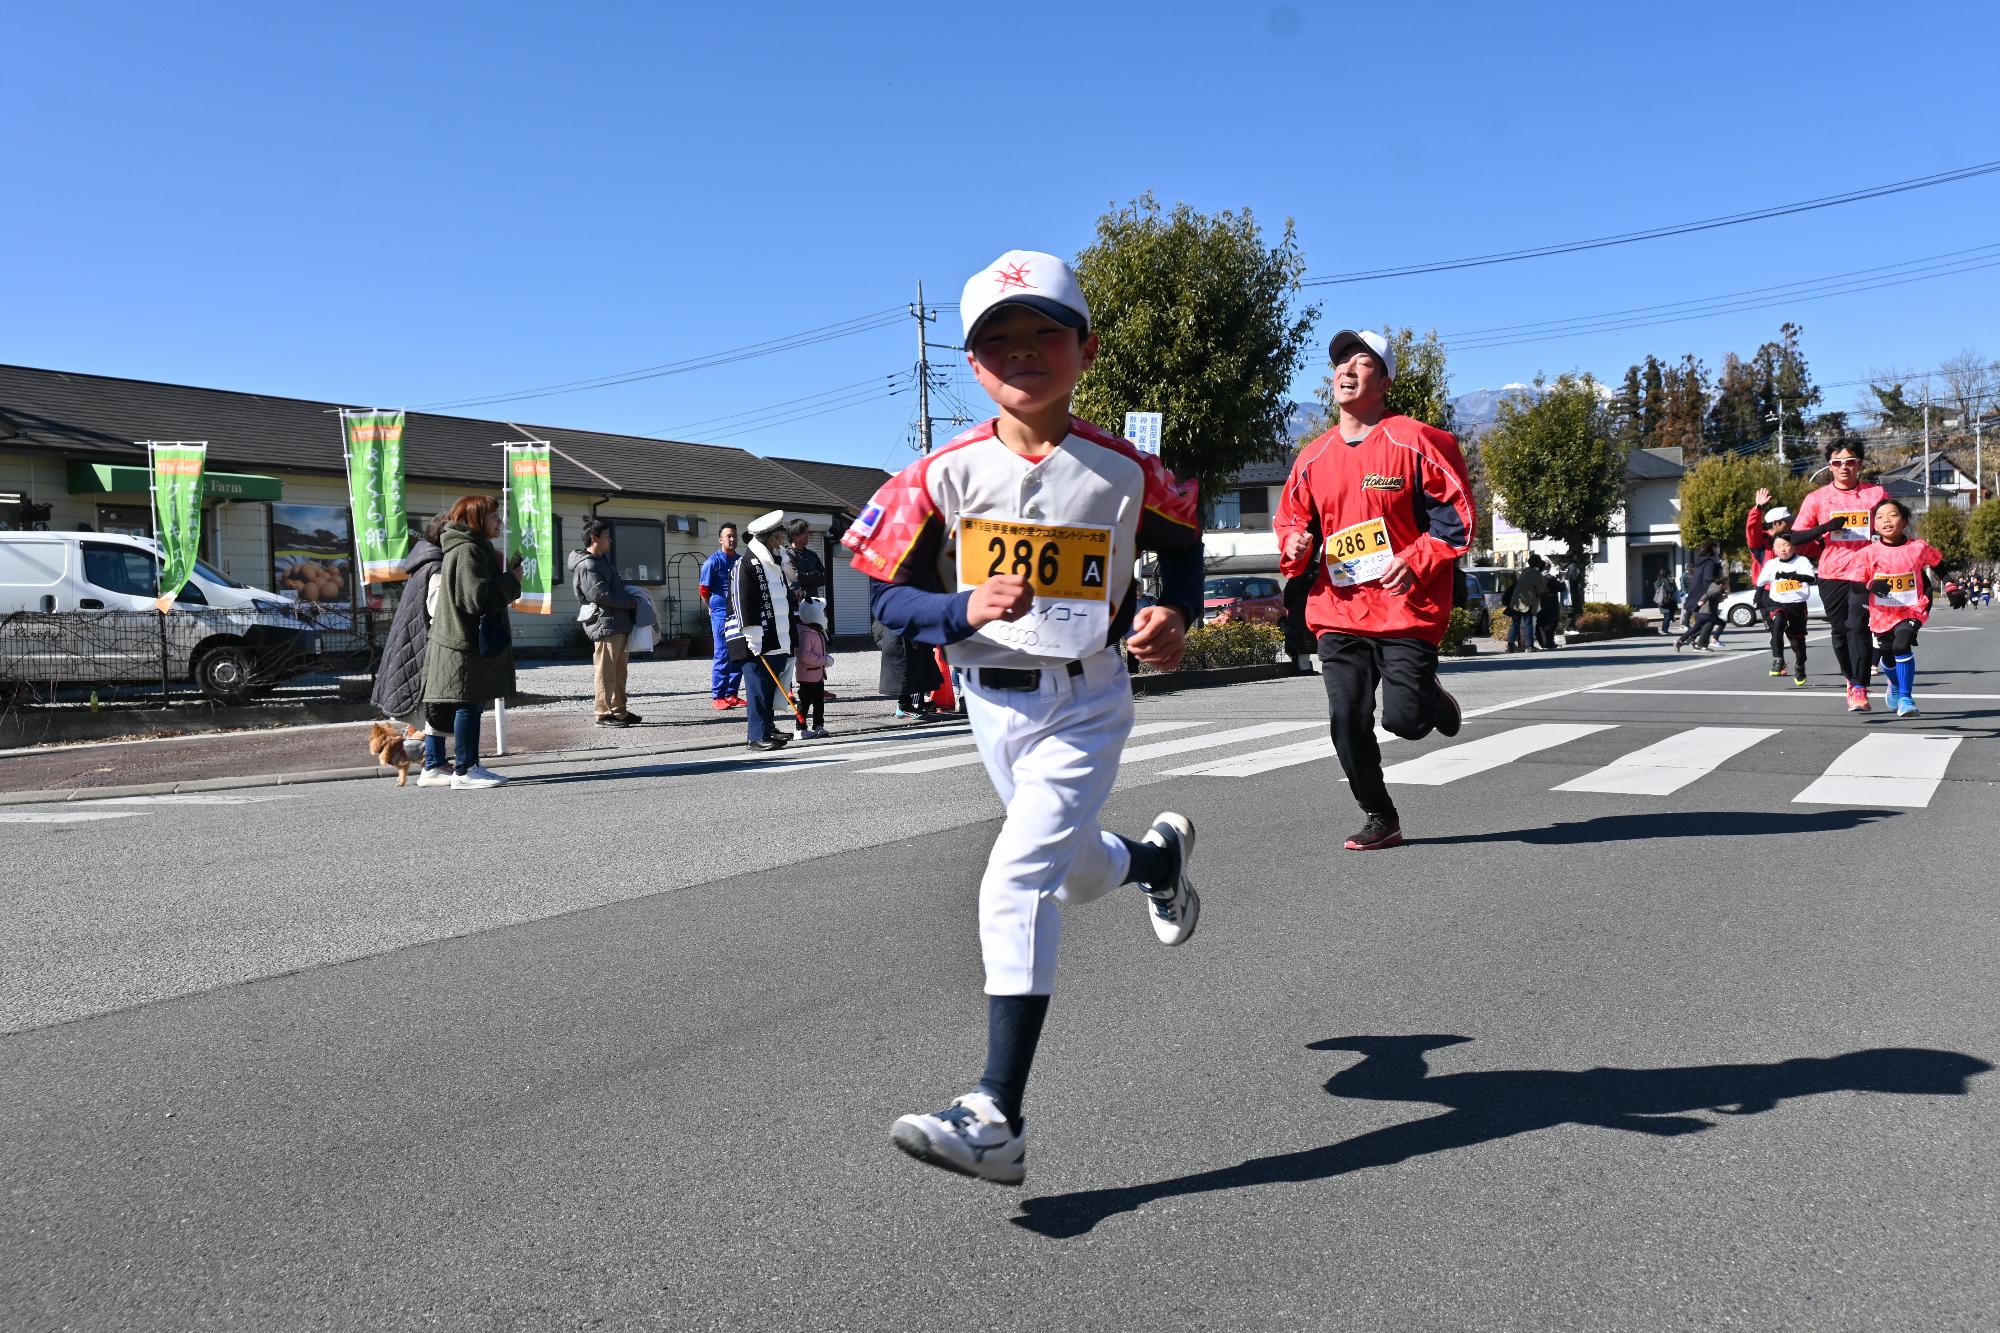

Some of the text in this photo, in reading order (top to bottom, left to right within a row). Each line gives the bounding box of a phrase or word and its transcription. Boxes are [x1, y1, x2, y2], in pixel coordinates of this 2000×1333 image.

[211, 479, 243, 493] Farm
[365, 448, 386, 554] さくら卵
[1336, 532, 1366, 558] 286
[988, 536, 1060, 586] 286
[1083, 559, 1101, 583] A
